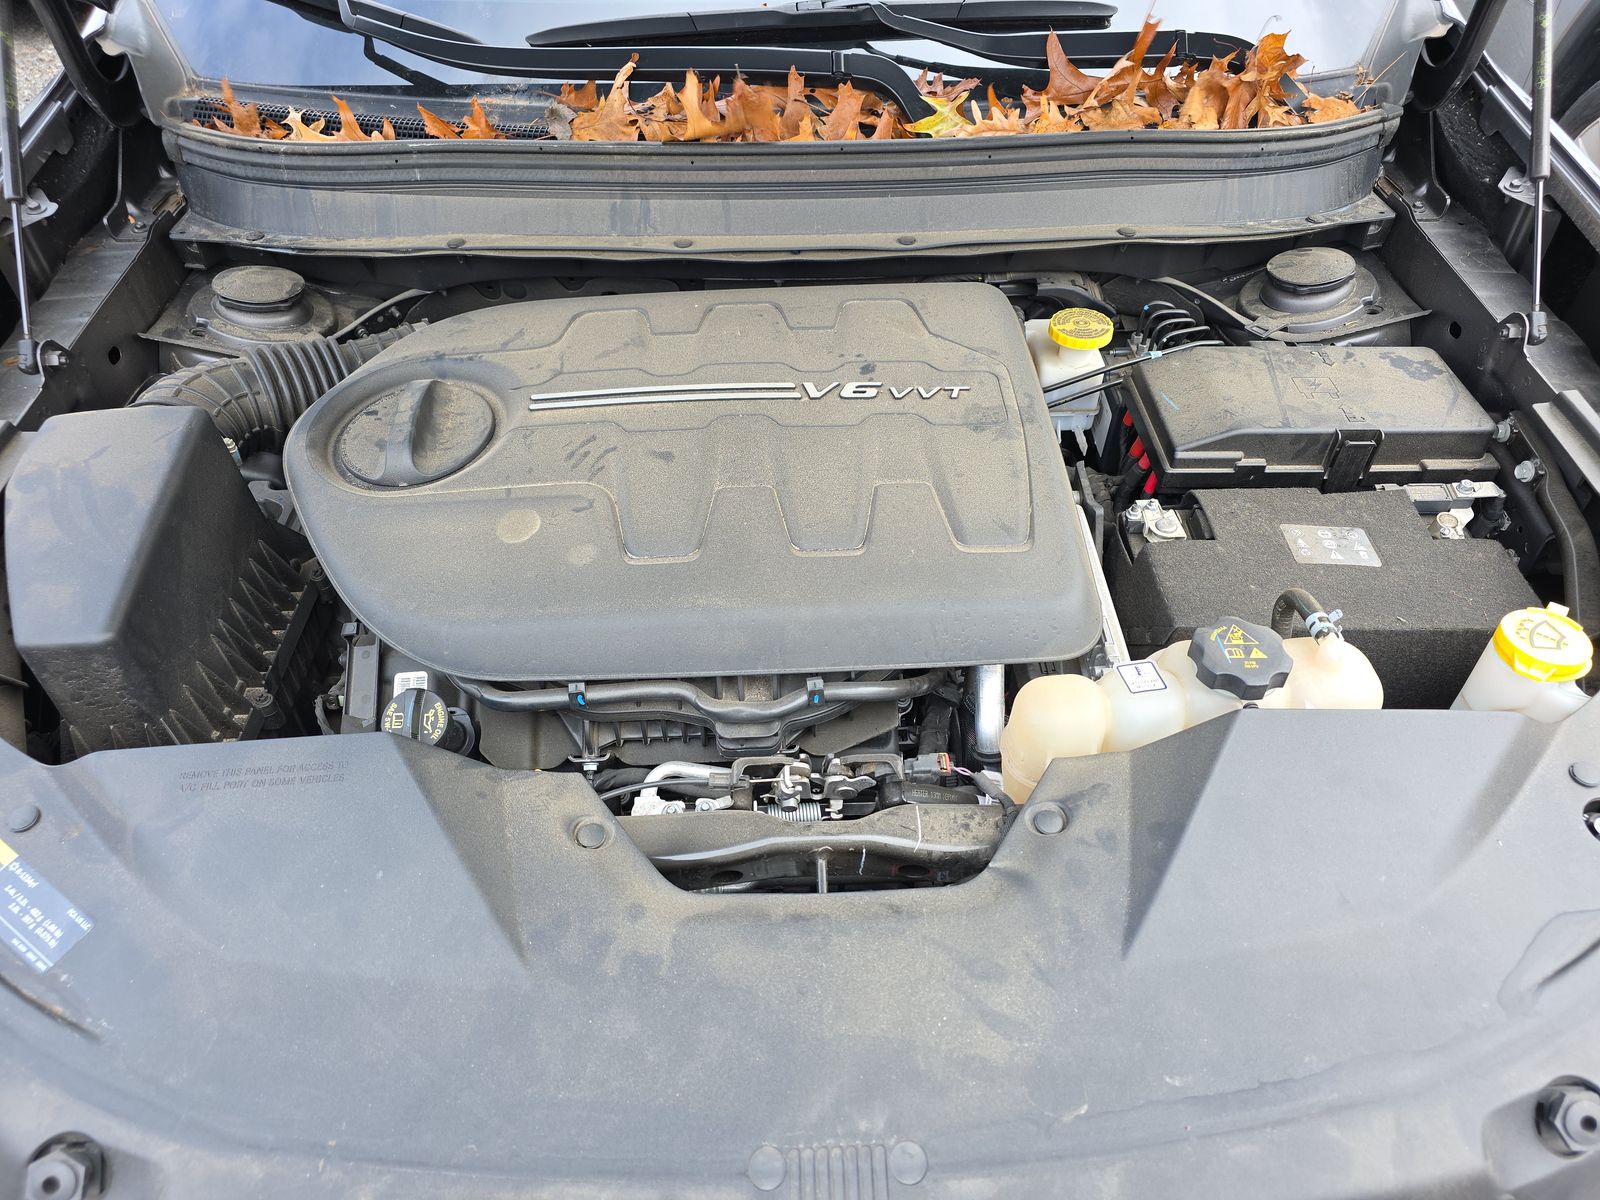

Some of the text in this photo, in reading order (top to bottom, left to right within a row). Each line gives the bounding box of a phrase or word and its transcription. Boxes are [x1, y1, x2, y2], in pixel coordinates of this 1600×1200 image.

[802, 381, 971, 400] V6 VVT
[386, 703, 398, 717] SAE
[430, 702, 446, 740] ENGINE OIL
[179, 769, 219, 780] REMOVE
[222, 767, 243, 778] THIS
[244, 765, 274, 776] PANEL
[276, 764, 297, 774] FOR
[299, 761, 334, 772] ACCESS
[200, 781, 220, 791] FILL
[223, 779, 249, 790] PORT
[251, 778, 267, 788] ON
[268, 776, 297, 787] SOME
[300, 773, 345, 785] VEHICLES
